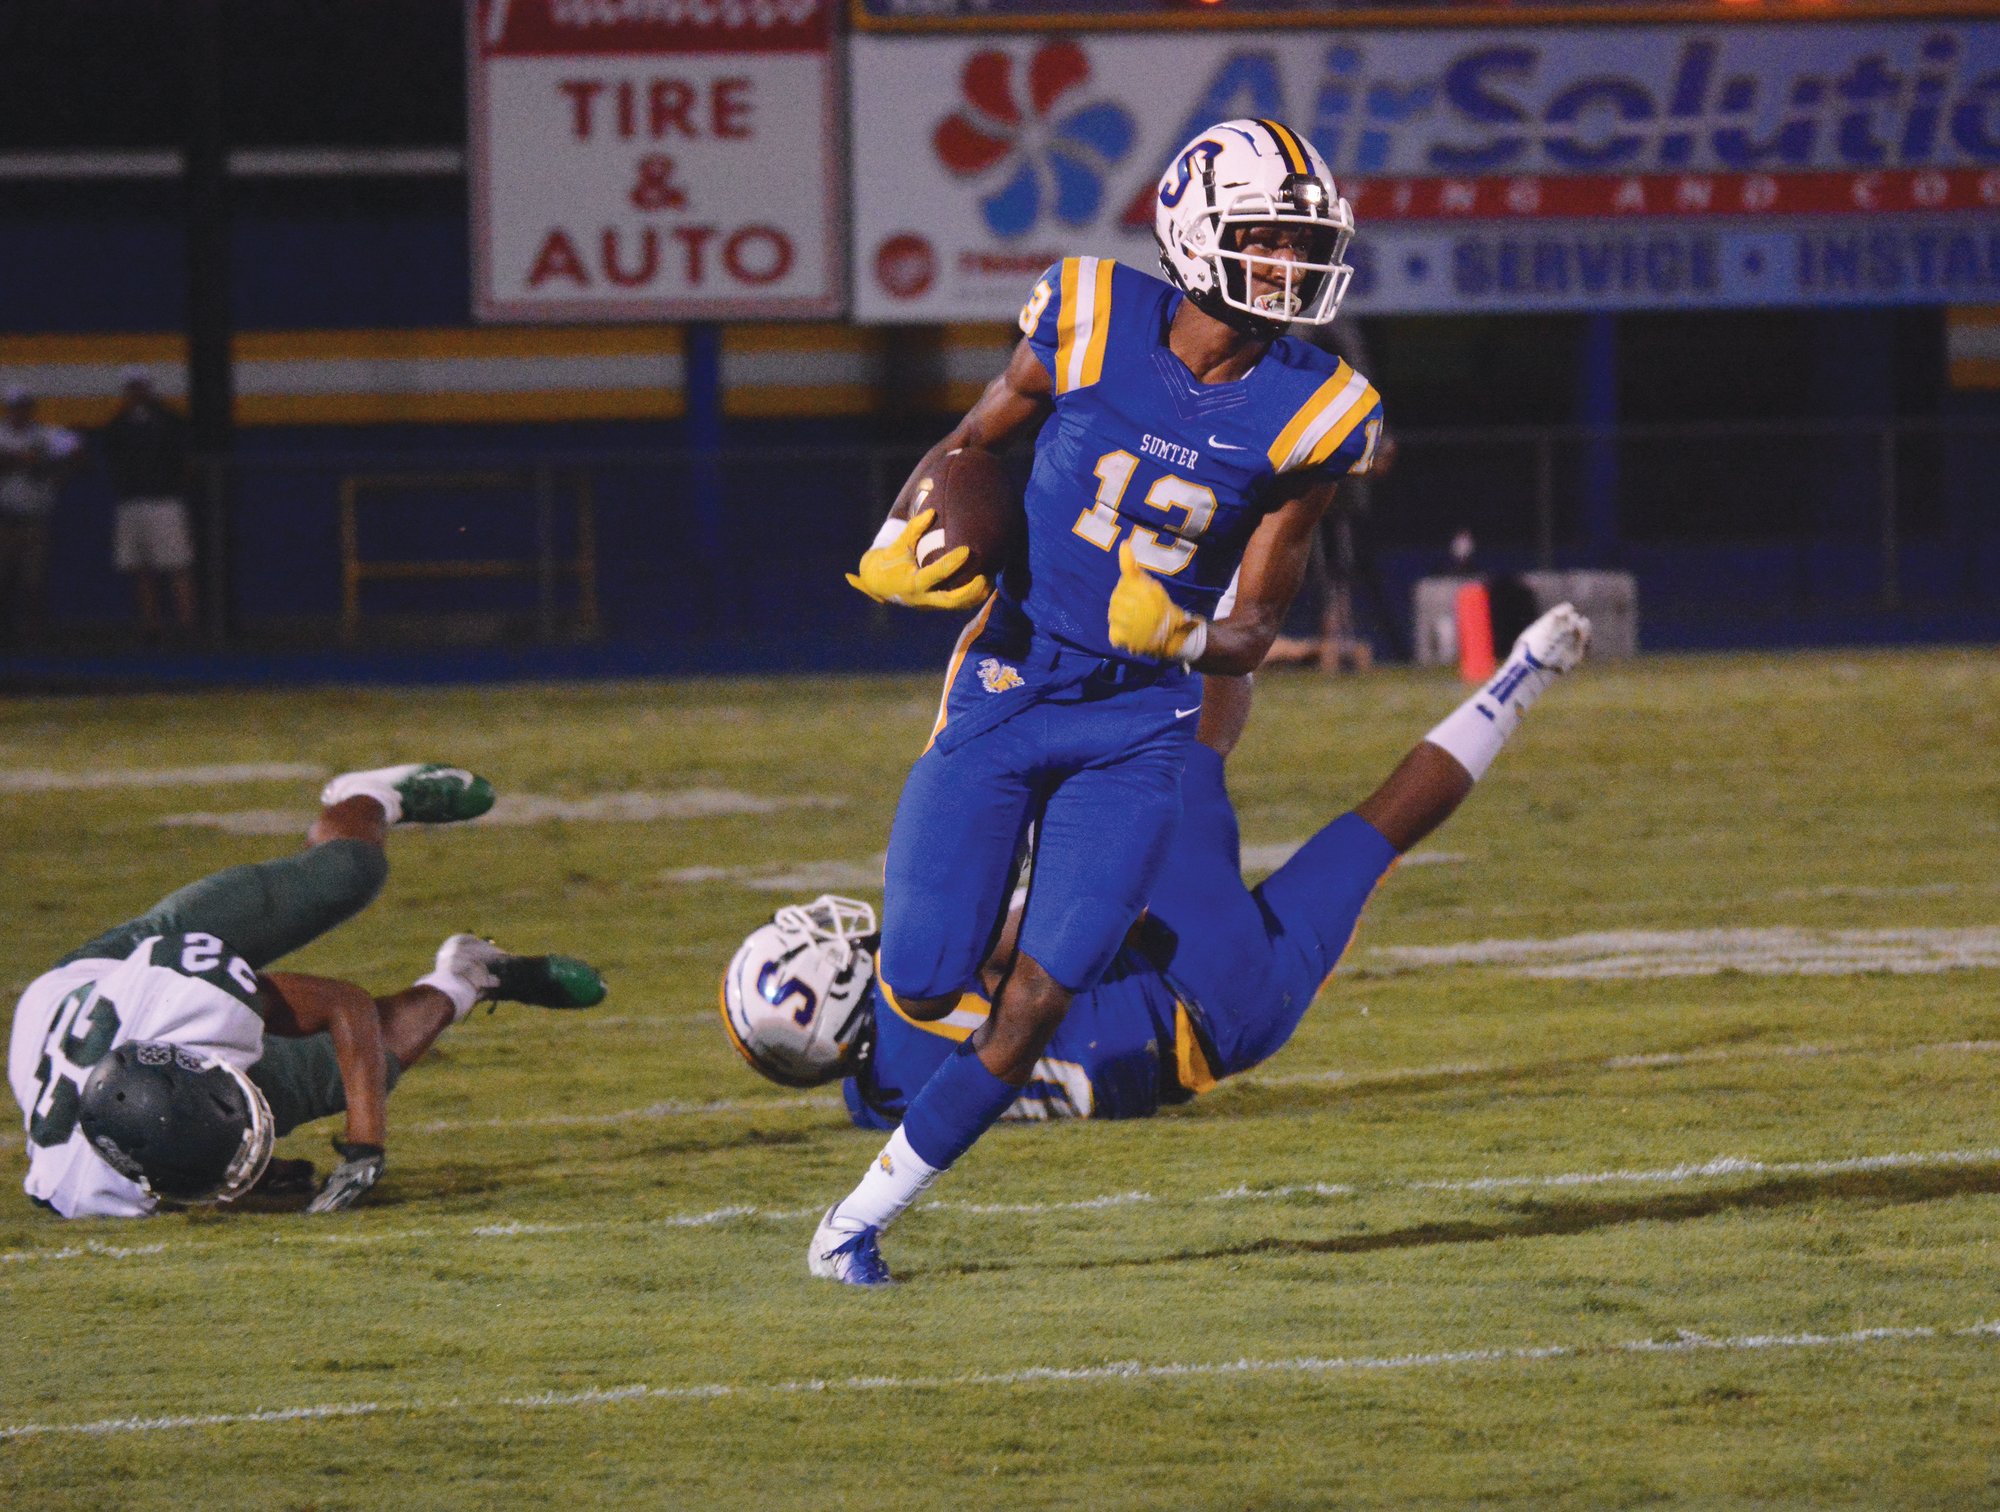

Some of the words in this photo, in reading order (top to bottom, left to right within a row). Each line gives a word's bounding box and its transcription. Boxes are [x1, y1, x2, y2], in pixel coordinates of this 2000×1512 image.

[559, 76, 754, 140] TIRE
[629, 154, 687, 211] &
[1613, 172, 1778, 211] AND
[526, 224, 794, 288] AUTO
[1452, 234, 1718, 293] SERVICE
[1140, 433, 1199, 470] SUMTER
[1072, 449, 1218, 576] 13
